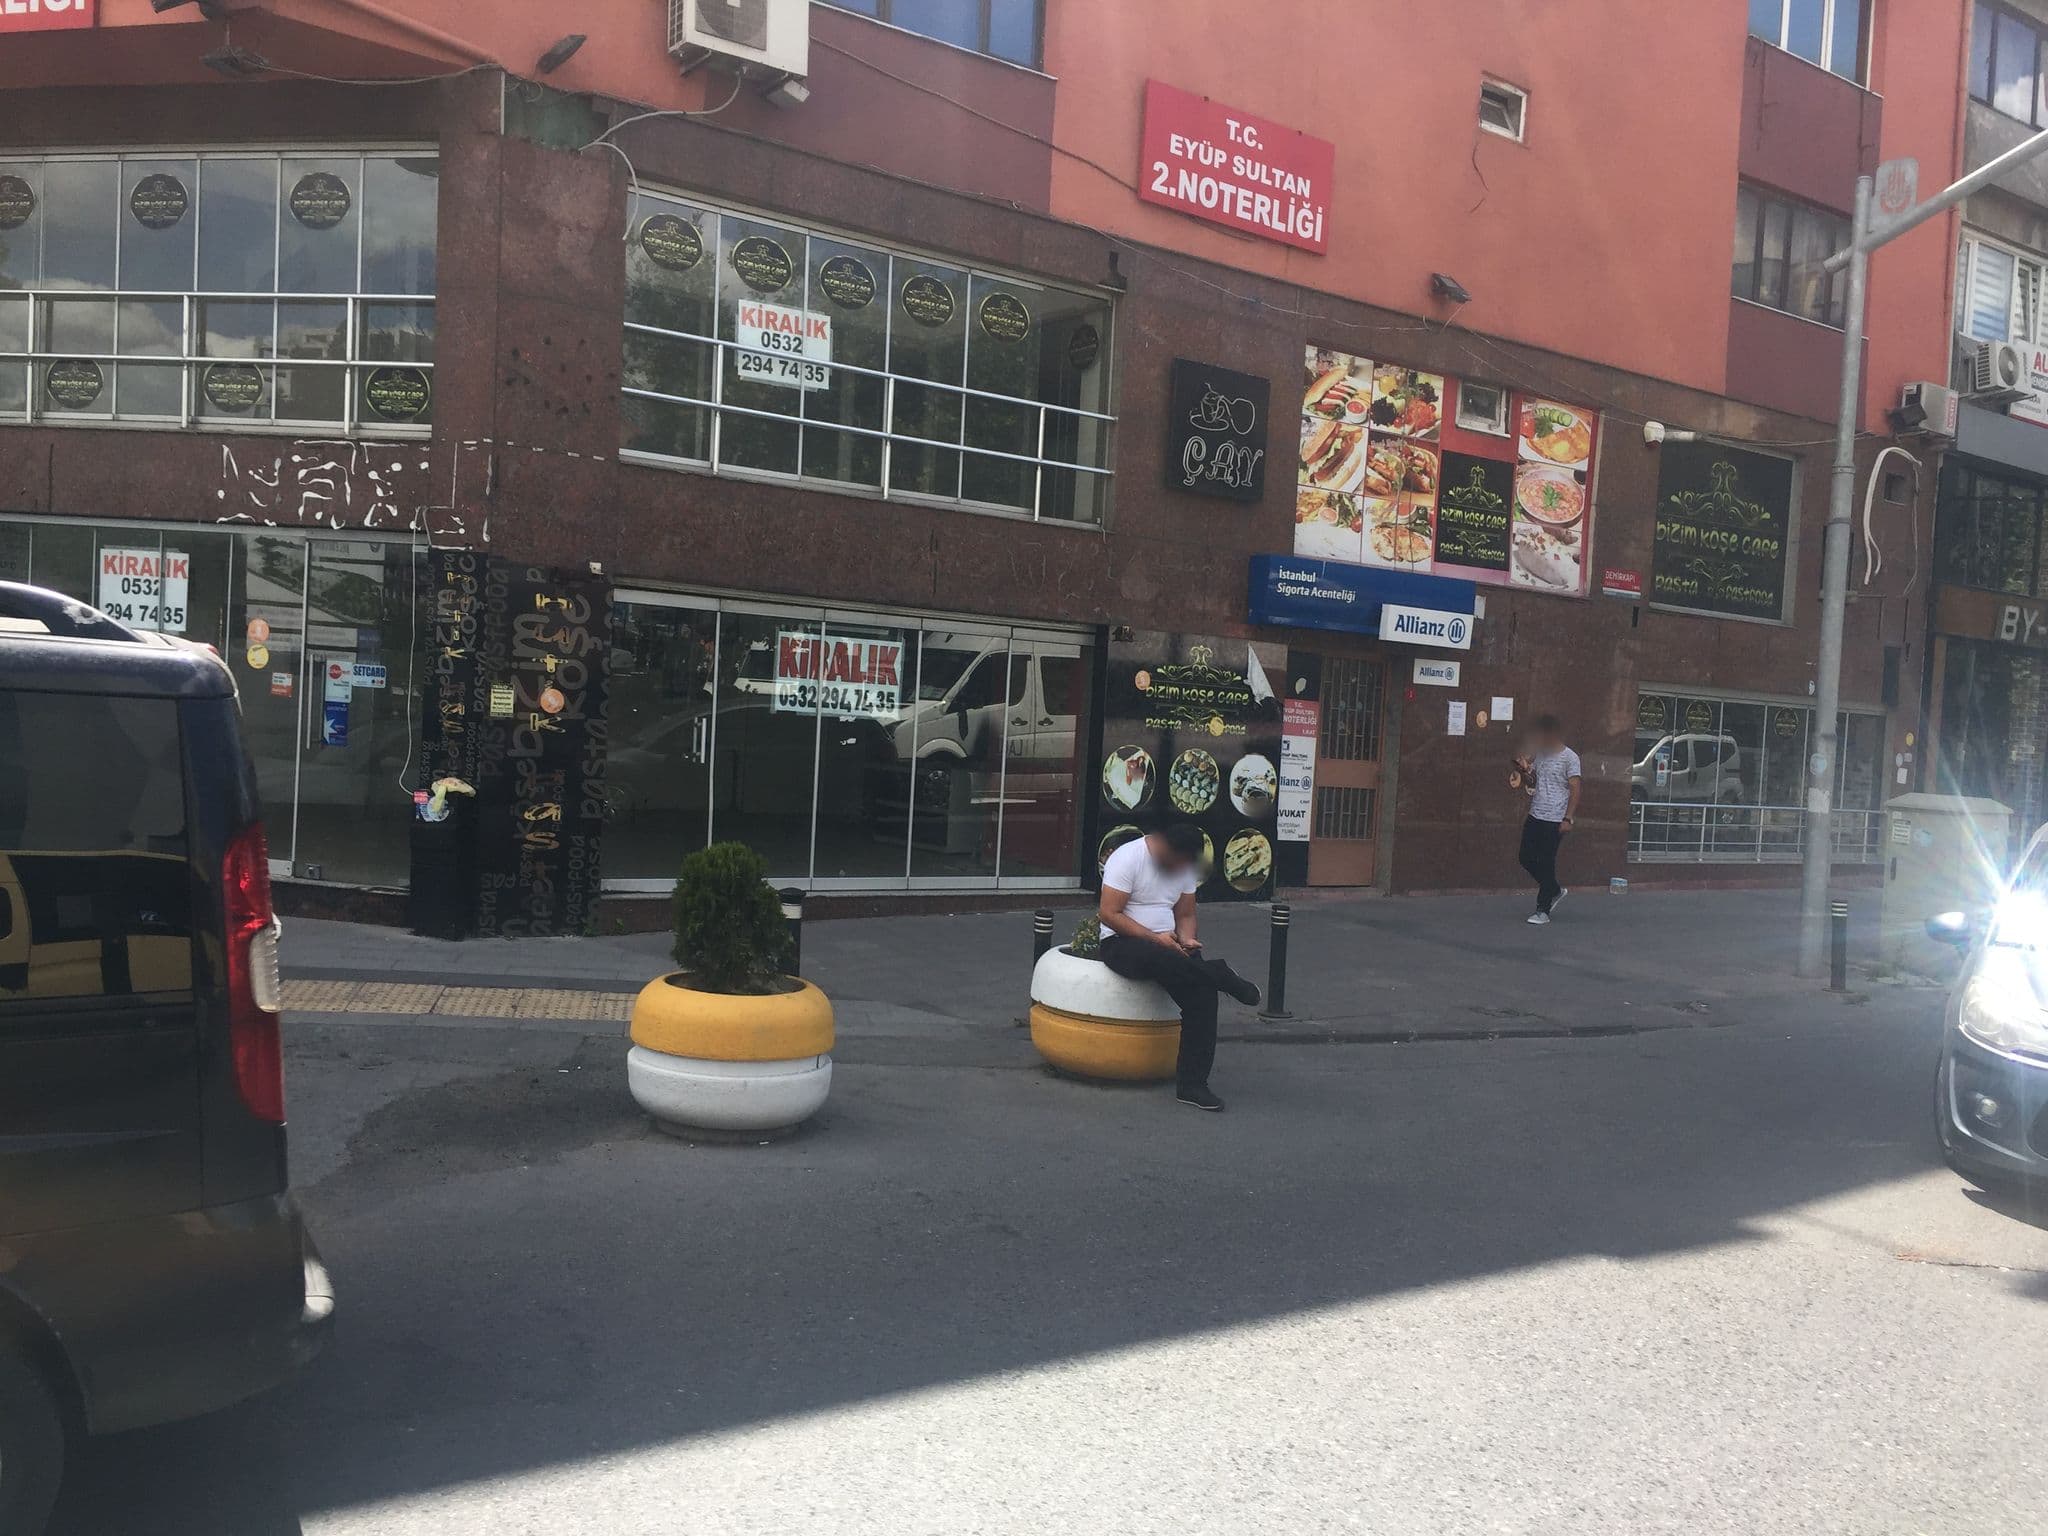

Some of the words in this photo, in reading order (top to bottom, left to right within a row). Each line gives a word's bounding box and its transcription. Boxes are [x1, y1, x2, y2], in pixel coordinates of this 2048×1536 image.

[1225, 118, 1264, 151] T.C.
[1169, 133, 1227, 169] EYÜP
[1232, 155, 1311, 198] SULTAN
[1151, 161, 1323, 243] 2.NOTERLİĞİ
[741, 304, 828, 340] KİRALIK
[761, 331, 803, 354] 0532
[742, 354, 774, 375] 294
[778, 360, 800, 379] 74
[804, 365, 825, 382] 35
[1183, 436, 1264, 487] ÇAY
[104, 551, 190, 579] KİRALIK
[1279, 566, 1316, 583] İstanbul
[121, 577, 160, 596] 0532
[1277, 582, 1310, 597] Sigorta
[1311, 586, 1357, 604] Acenteliği
[105, 602, 133, 621] 294
[139, 605, 159, 622] 74
[163, 606, 184, 625] 35
[1394, 614, 1444, 637] Allianz
[352, 665, 386, 678] SETCARD
[779, 636, 900, 686] KİRALIK
[1419, 666, 1444, 678] Allianz
[779, 684, 817, 708] 0532
[821, 686, 851, 713] 294
[854, 689, 874, 714] 74
[875, 690, 895, 713] 35
[1277, 809, 1306, 818] VUKAT
